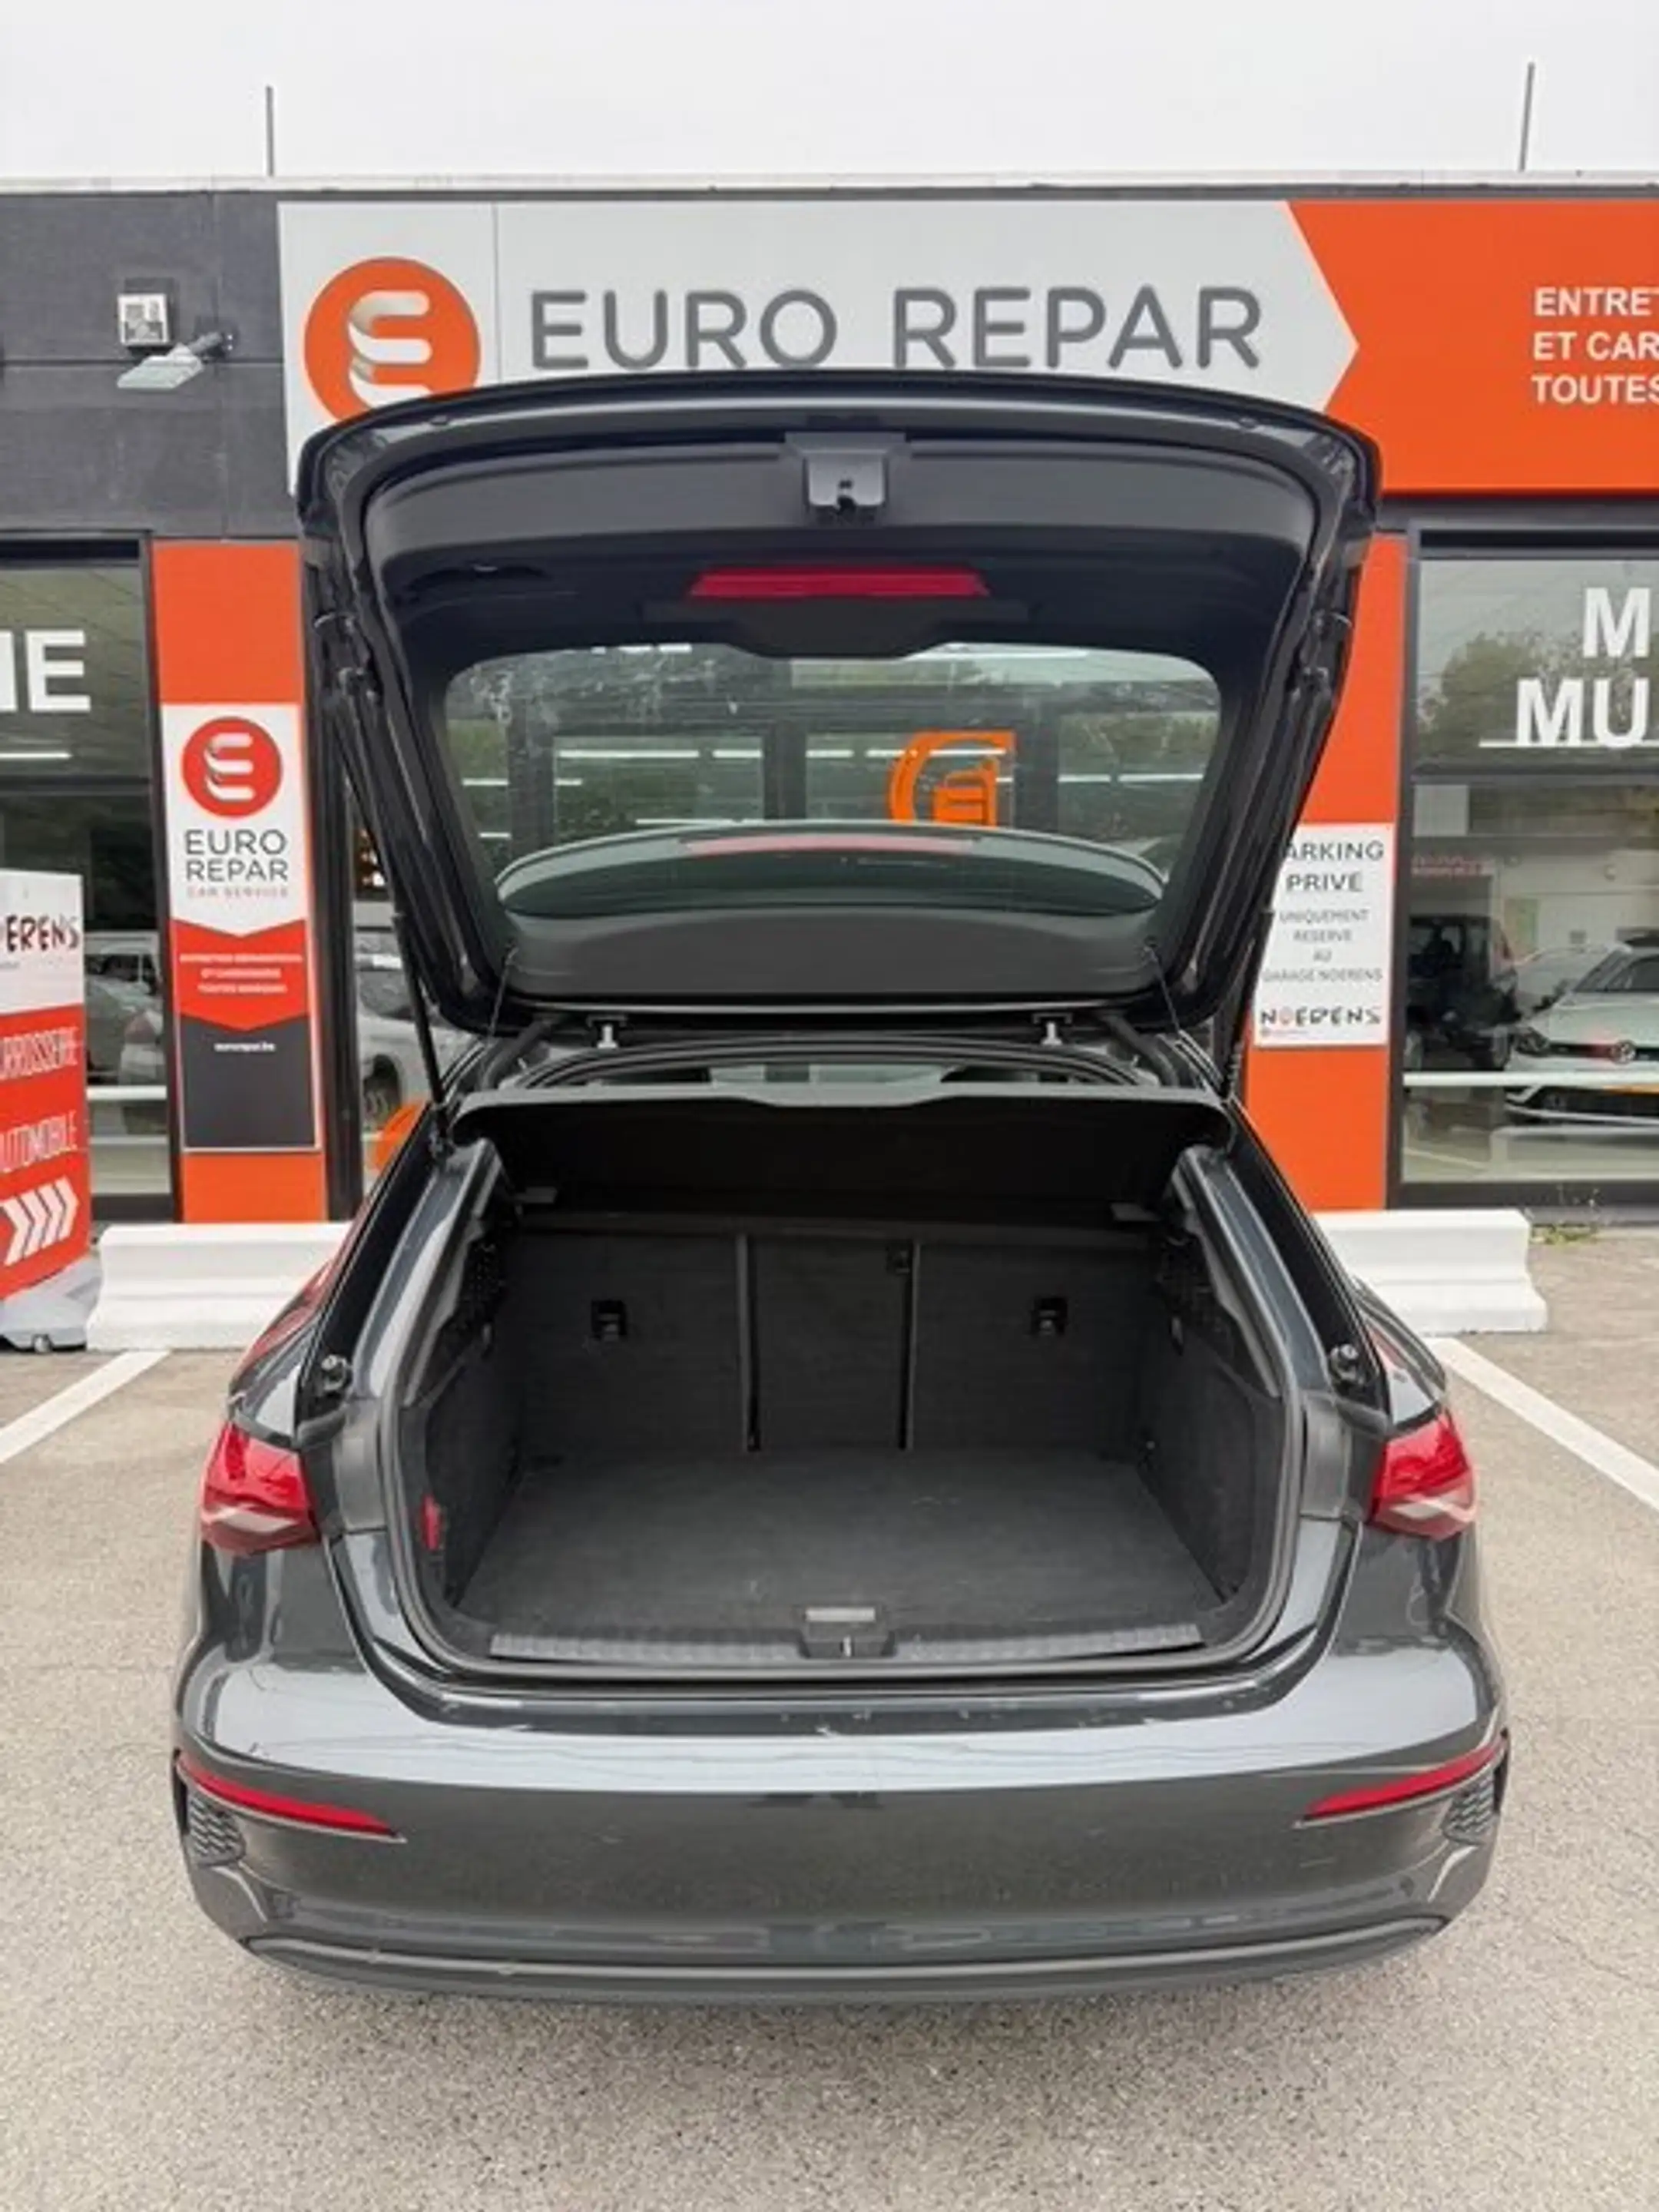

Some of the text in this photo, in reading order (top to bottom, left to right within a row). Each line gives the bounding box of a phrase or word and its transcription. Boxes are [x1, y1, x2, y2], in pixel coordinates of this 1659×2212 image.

[531, 284, 1261, 371] EURO REPAR
[1534, 330, 1659, 362] ET CAR
[1531, 373, 1659, 406] TOUTES
[1517, 677, 1650, 749] MU
[185, 829, 287, 855] EURO
[1284, 839, 1384, 861] ARKING
[186, 859, 288, 882] REPAR
[0, 913, 80, 952] ERENS
